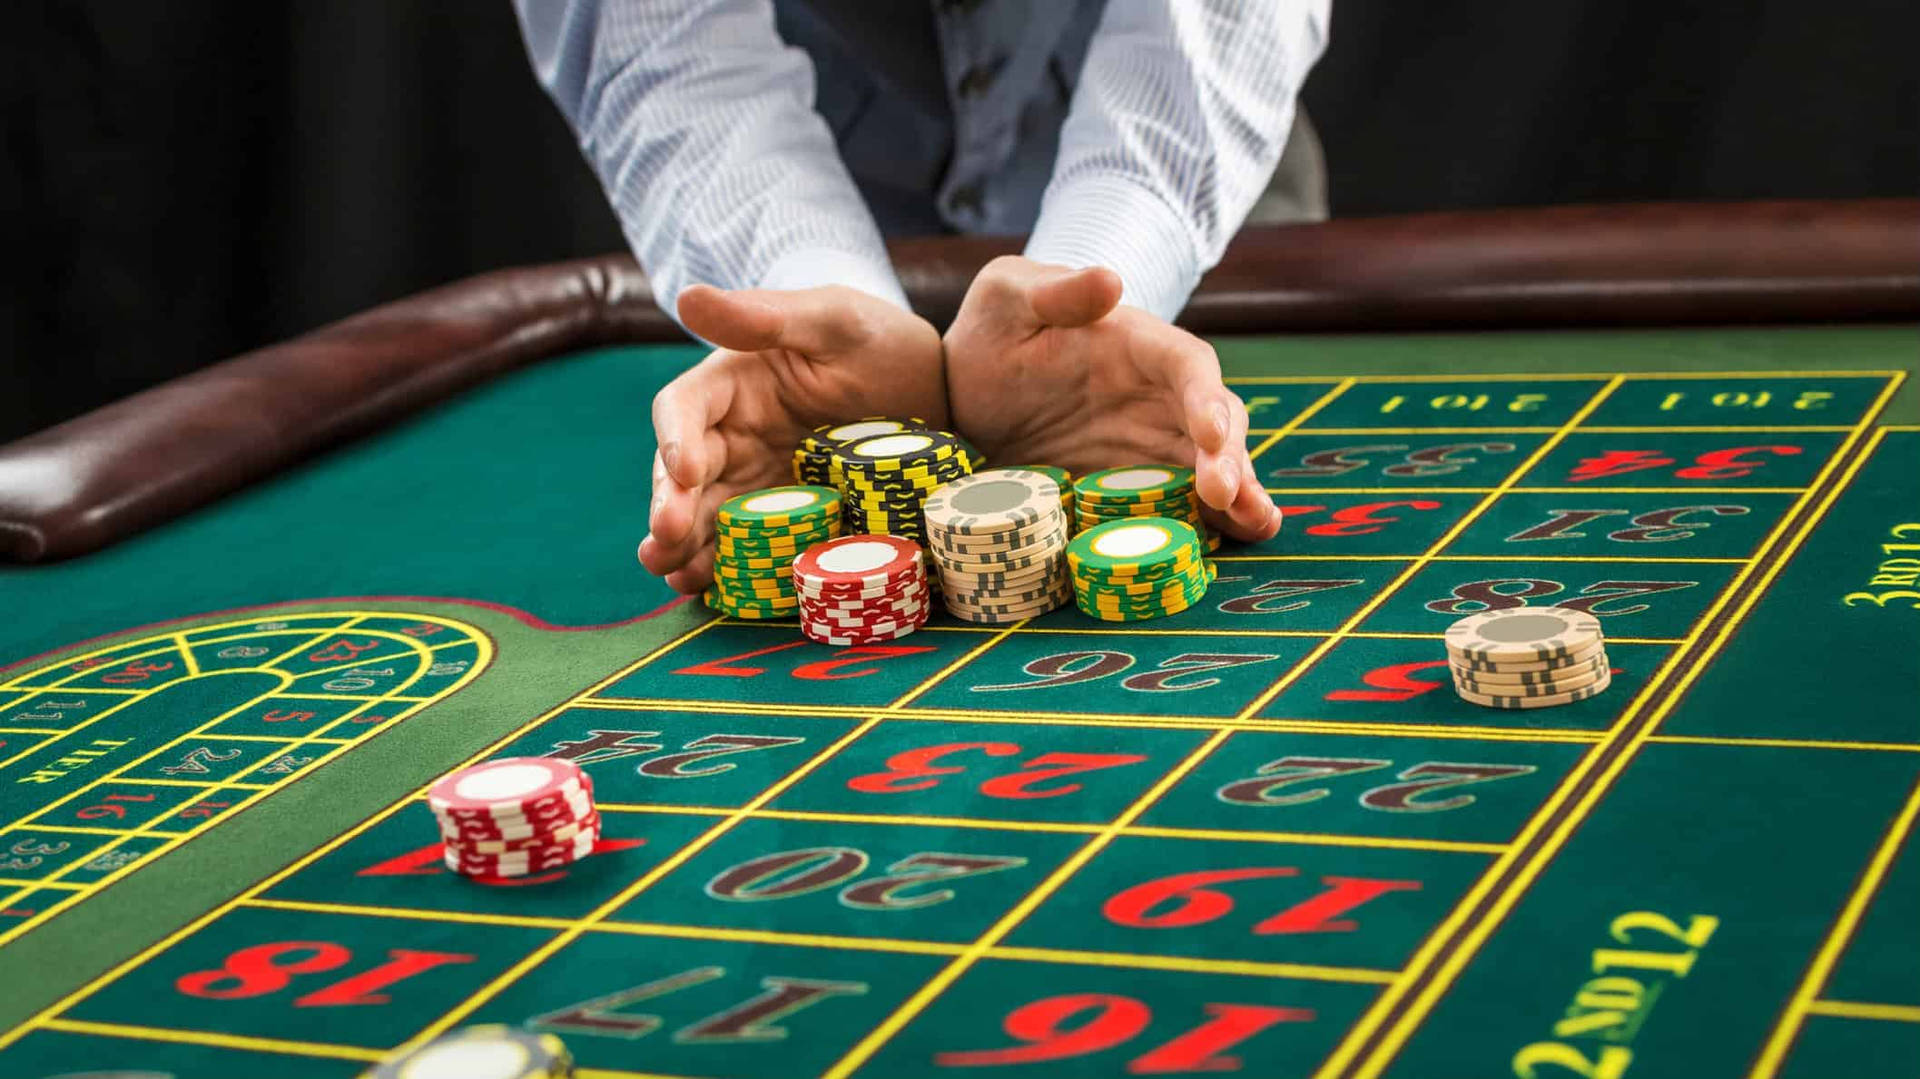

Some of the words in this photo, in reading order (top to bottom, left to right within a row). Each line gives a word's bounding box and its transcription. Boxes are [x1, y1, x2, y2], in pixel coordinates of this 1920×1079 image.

[1380, 395, 1405, 413] 1
[1508, 394, 1548, 412] 2
[1660, 392, 1683, 411] 1
[1793, 391, 1833, 410] 2
[1269, 442, 1516, 478] 35
[1568, 445, 1802, 482] 34
[1503, 504, 1751, 543] 31
[1212, 575, 1366, 615] 2
[1424, 577, 1700, 616] 28
[309, 639, 379, 662] 23
[672, 641, 937, 680] 27
[102, 660, 173, 684] 30
[322, 668, 394, 691] 10
[969, 650, 1281, 693] 26
[10, 700, 86, 721] 11
[263, 710, 315, 722] 5
[16, 738, 136, 784] TIER
[160, 748, 242, 775] 24
[541, 730, 804, 778] 24
[847, 742, 1147, 799] 23
[1216, 756, 1537, 813] 22
[77, 794, 155, 819] 16
[706, 846, 1027, 909] 20
[1102, 867, 1422, 935] 19
[175, 941, 476, 1007] 18
[527, 966, 867, 1042] 17
[936, 994, 1316, 1073] 16
